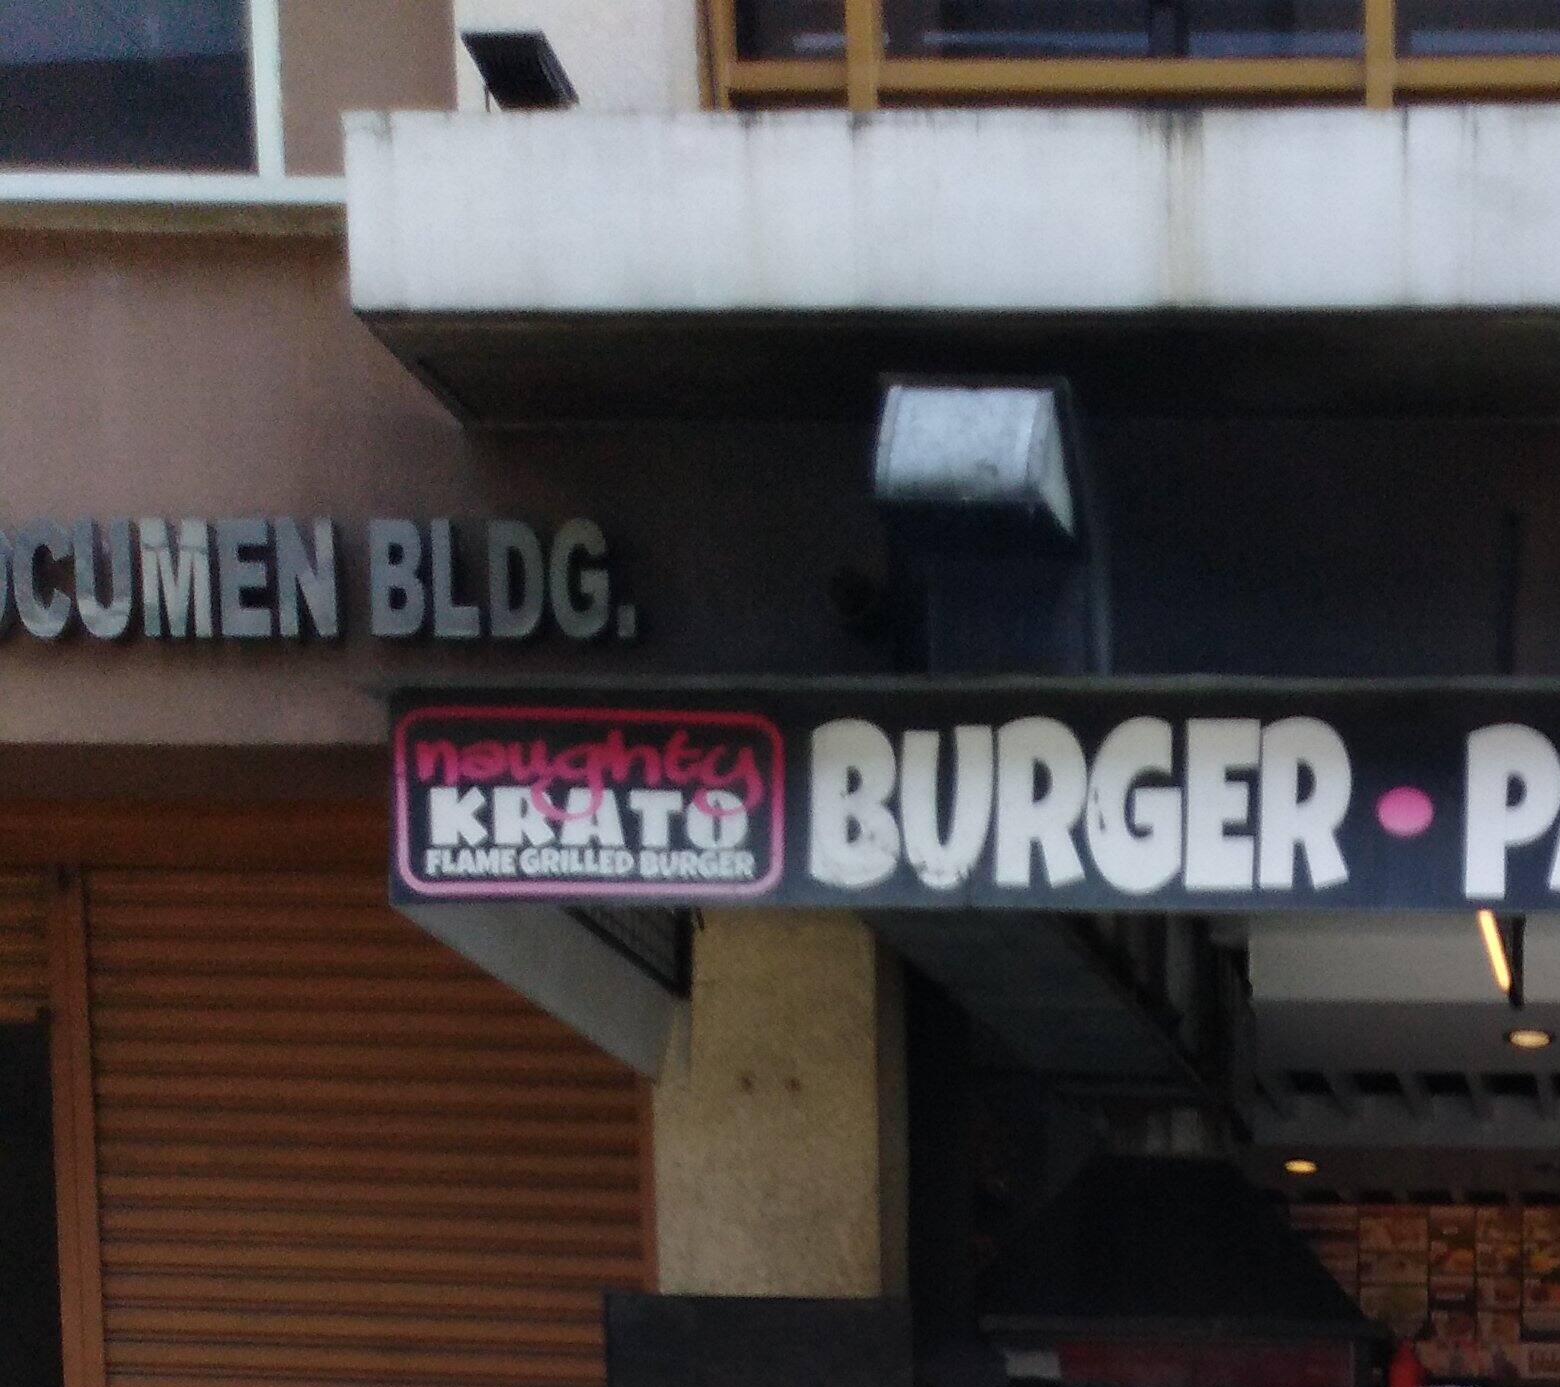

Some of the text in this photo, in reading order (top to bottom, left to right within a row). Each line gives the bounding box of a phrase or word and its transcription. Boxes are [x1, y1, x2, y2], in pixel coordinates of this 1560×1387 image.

[0, 516, 637, 638] CUMEN BLDG.
[415, 728, 763, 817] naughty
[808, 715, 1353, 895] BURGER
[428, 786, 749, 850] KRATO
[424, 847, 755, 879] FLAME GRILLED BURGER
